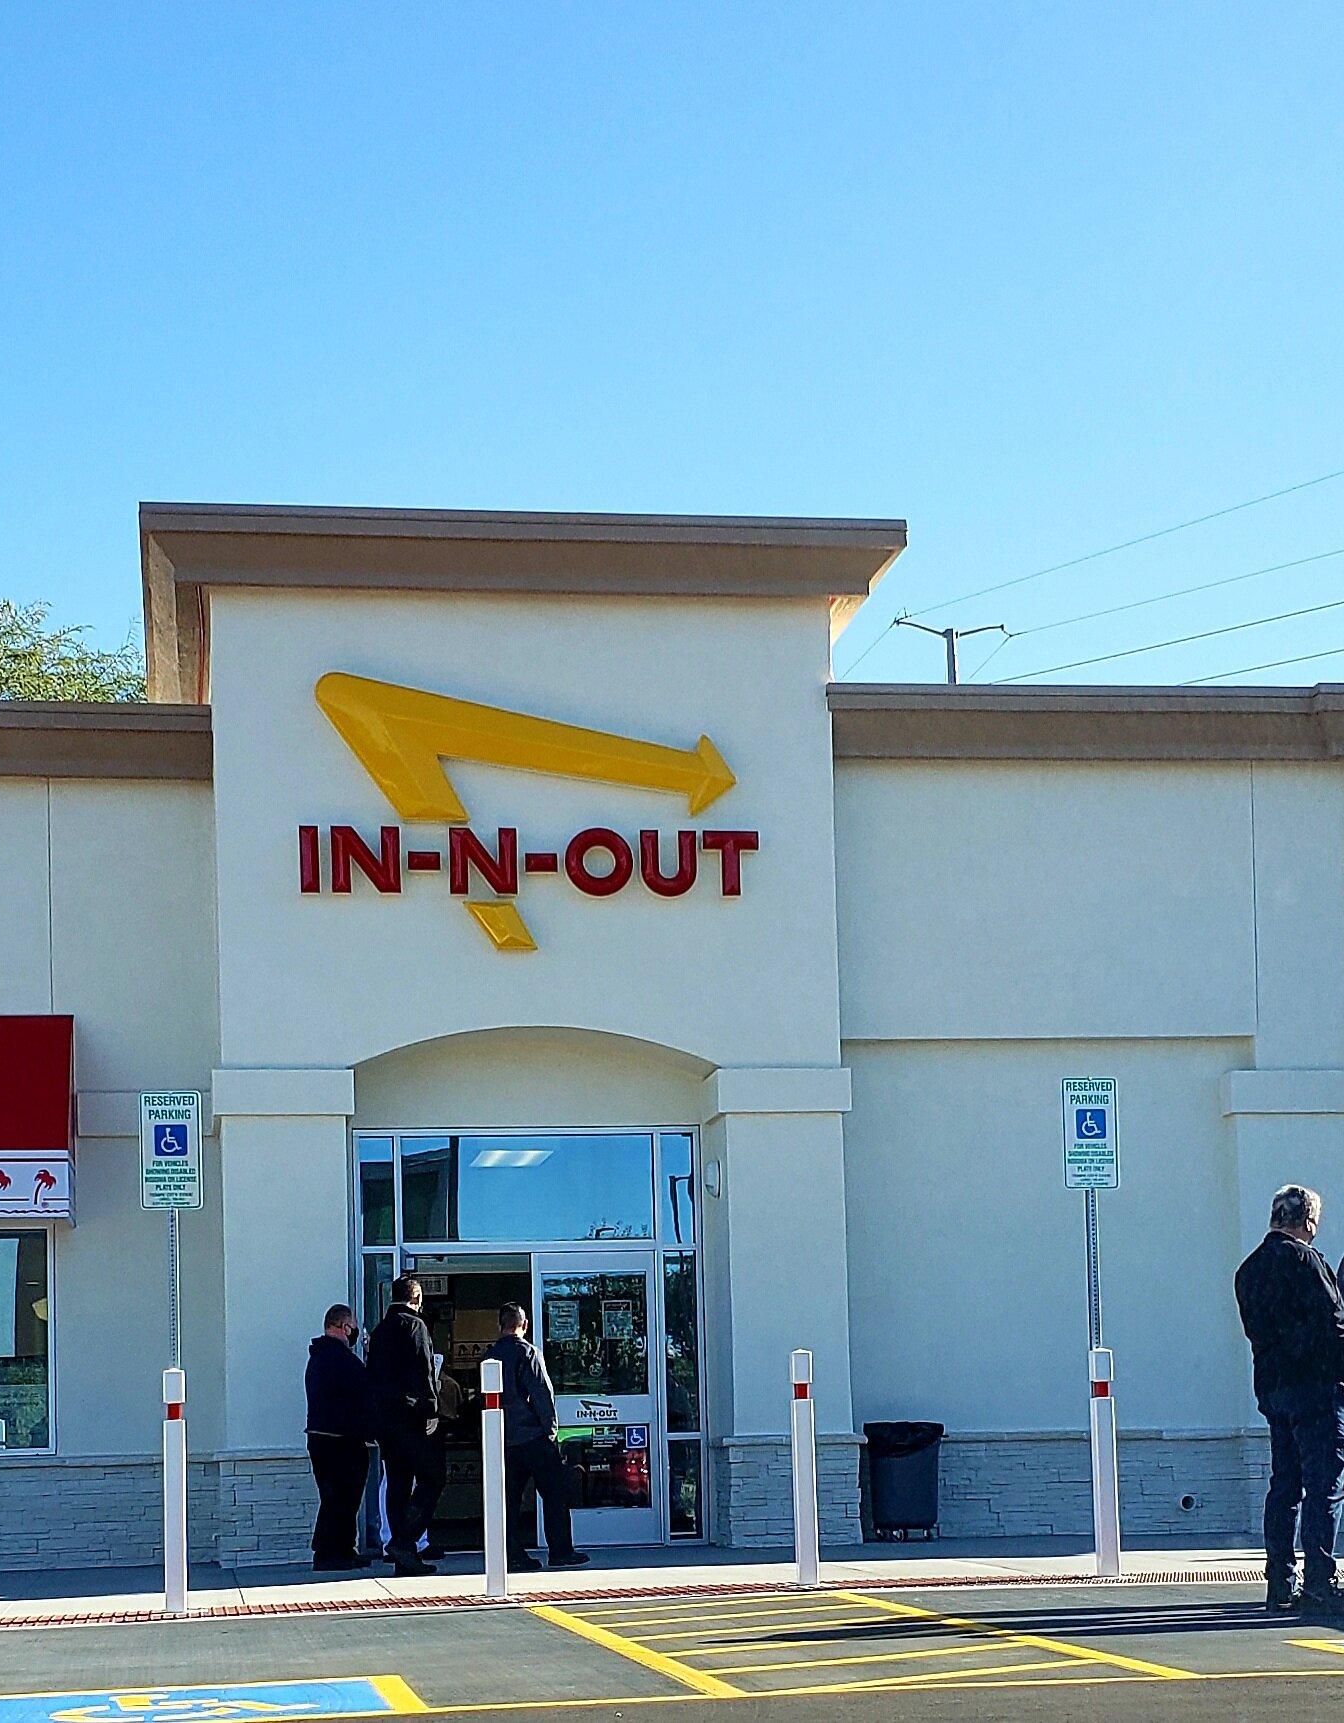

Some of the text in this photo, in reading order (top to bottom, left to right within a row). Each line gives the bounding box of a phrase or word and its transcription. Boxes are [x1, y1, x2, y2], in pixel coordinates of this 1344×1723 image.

[298, 824, 761, 899] IN-N-OUT
[1066, 1081, 1112, 1092] RESERVED
[144, 1095, 195, 1107] RESERVED
[1070, 1094, 1109, 1105] PARKING
[148, 1109, 191, 1120] PARKING
